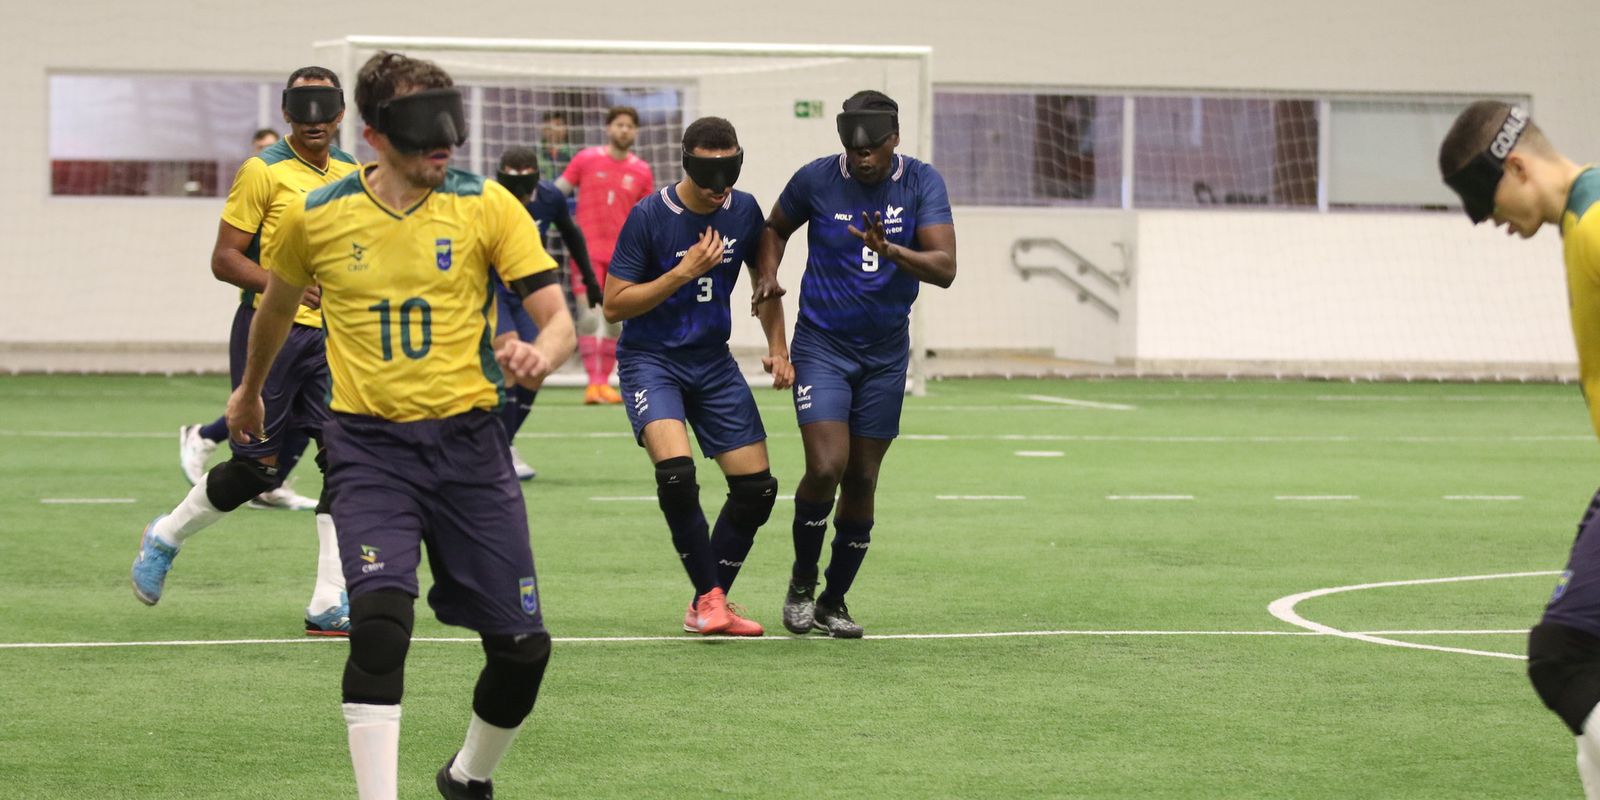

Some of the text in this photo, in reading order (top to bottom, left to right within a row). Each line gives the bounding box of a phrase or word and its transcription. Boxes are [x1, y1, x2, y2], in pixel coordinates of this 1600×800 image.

[675, 250, 688, 258] NO
[861, 245, 879, 272] 9
[696, 277, 713, 303] 3
[368, 297, 432, 361] 10
